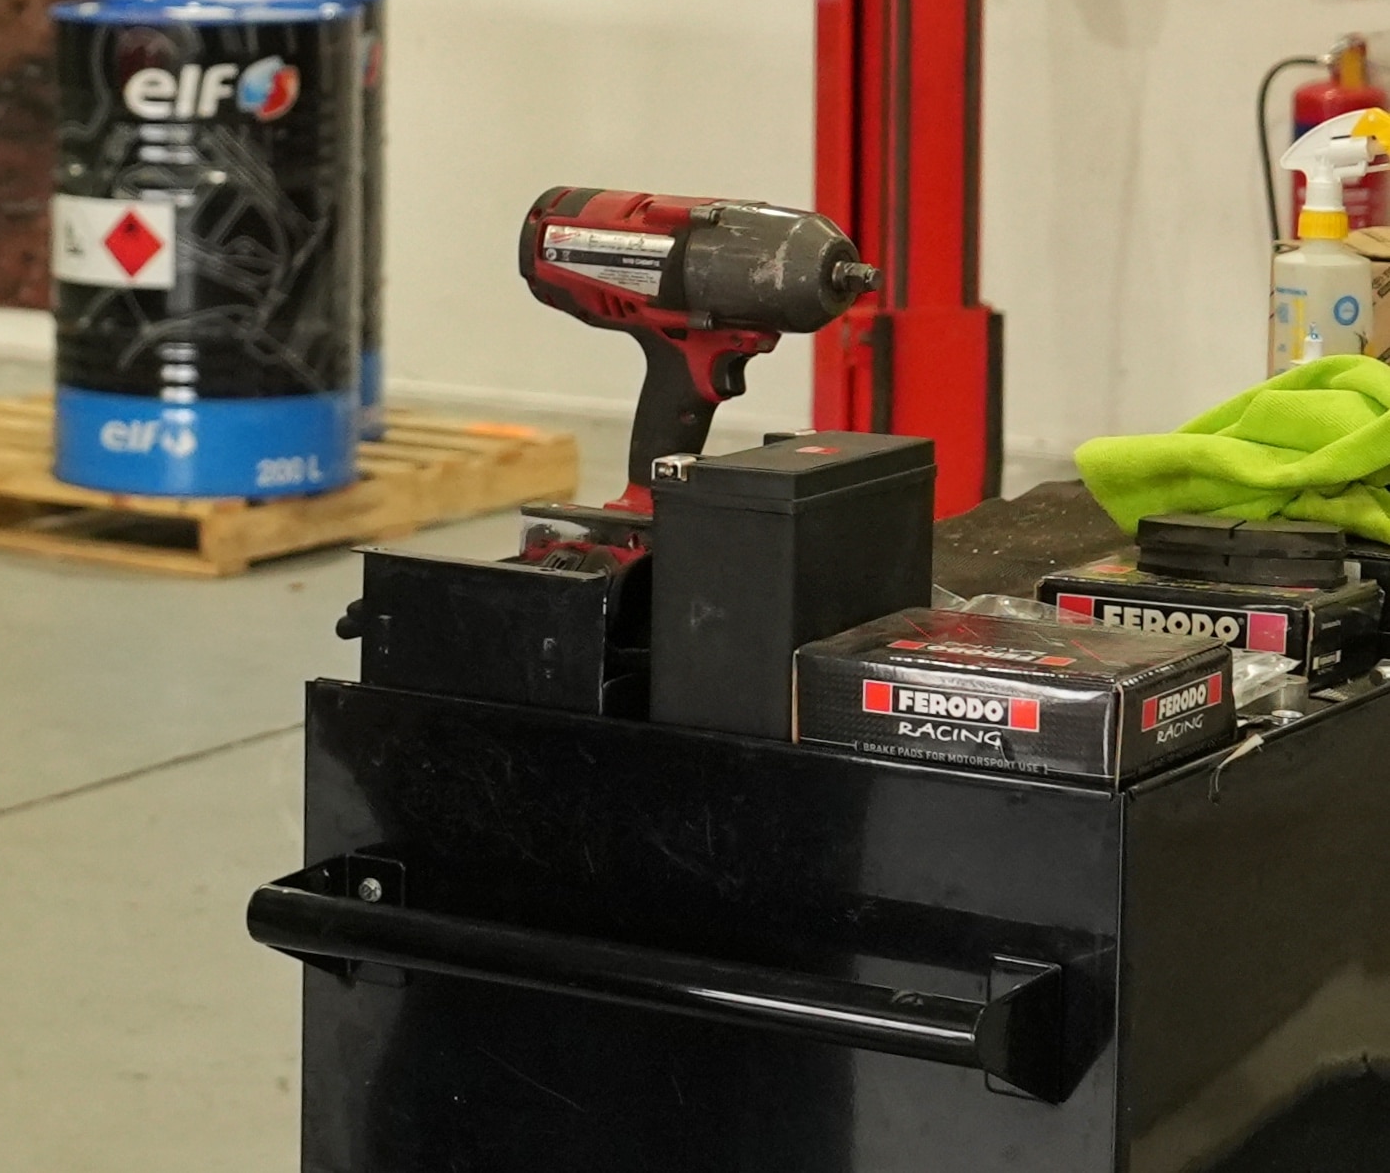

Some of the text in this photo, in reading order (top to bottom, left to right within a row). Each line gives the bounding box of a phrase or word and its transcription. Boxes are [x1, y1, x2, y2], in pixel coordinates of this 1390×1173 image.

[125, 64, 239, 118] elf
[101, 420, 160, 453] elf
[1103, 604, 1241, 645] FERODO
[898, 689, 1005, 723] FERODO
[1157, 683, 1207, 720] FERODO
[897, 721, 1004, 750] RACING
[1156, 713, 1204, 744] RACING
[862, 742, 1040, 773] BRAKE PADS FOR MOTORSPORT USE
